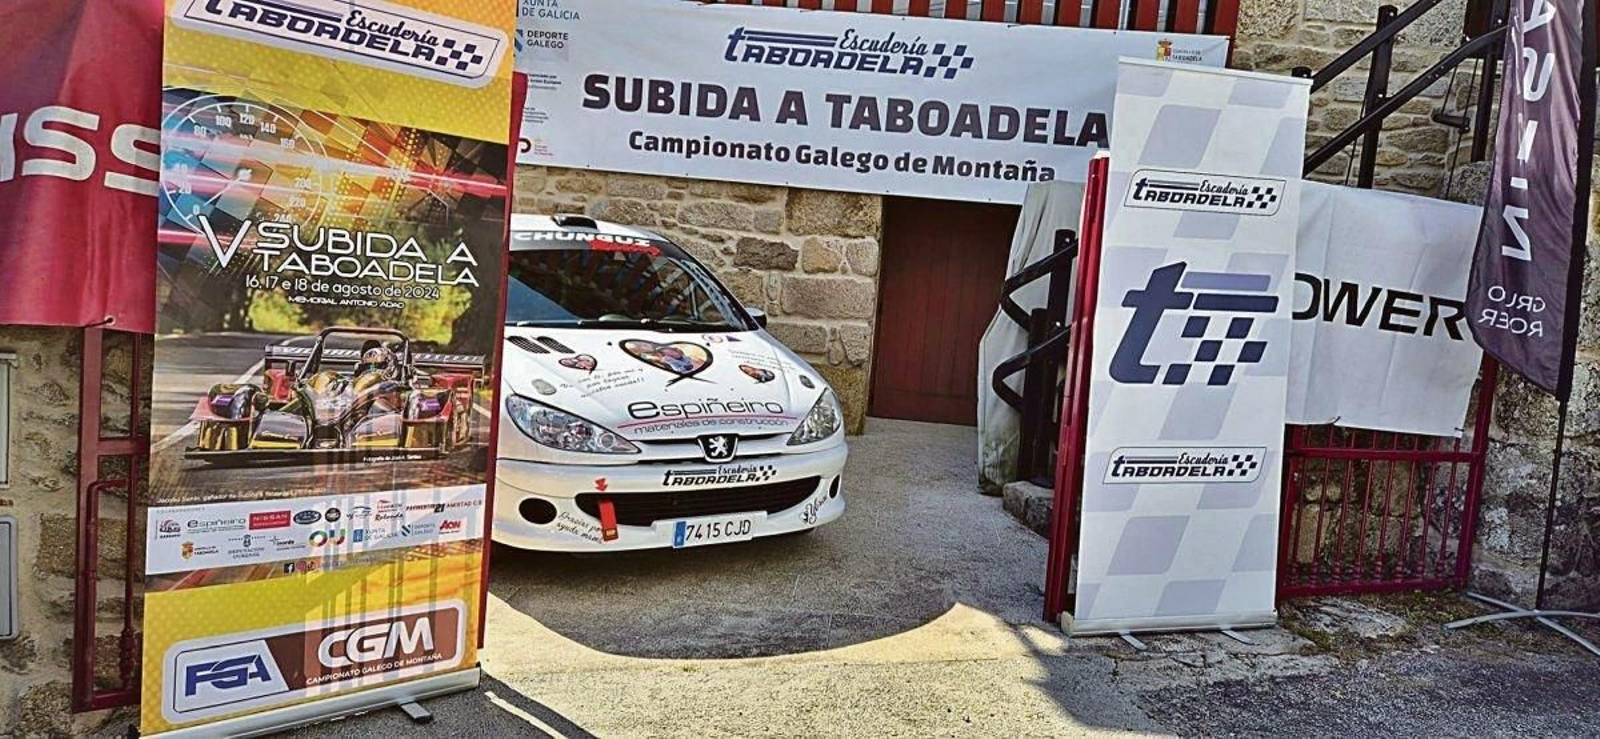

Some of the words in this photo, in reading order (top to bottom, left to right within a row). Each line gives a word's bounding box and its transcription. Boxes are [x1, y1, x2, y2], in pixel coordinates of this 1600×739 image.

[522, 7, 535, 17] DE
[538, 9, 580, 20] GALICIA
[346, 10, 439, 47] Escudería
[528, 30, 569, 40] DEPORTE
[527, 40, 564, 49] GALEGO
[839, 28, 929, 56] Escudería
[240, 113, 255, 125] 120
[582, 73, 761, 122] SUBIDA
[775, 90, 808, 126] A
[825, 93, 1109, 148] TABOADELA
[260, 122, 277, 134] 140
[629, 131, 790, 162] Campionato
[795, 144, 889, 174] Galego
[894, 151, 928, 173] de
[932, 155, 1055, 182] Montaña
[1199, 179, 1249, 196] Escudería
[198, 216, 251, 268] V
[255, 222, 427, 261] SUBIDA
[446, 241, 478, 266] A
[253, 249, 479, 287] TABOADELA
[265, 276, 279, 289] 17
[281, 280, 292, 290] e
[295, 279, 308, 291] 18
[311, 279, 329, 293] de
[332, 281, 381, 297] agosto
[384, 285, 401, 297] de
[404, 286, 440, 299] 2024
[288, 295, 338, 305] MEMORIAL
[340, 298, 378, 307] ANTONIO
[627, 398, 783, 419] espiñeiro
[634, 419, 700, 435] materiales
[703, 418, 717, 426] de
[720, 418, 788, 427] construcción
[1177, 452, 1229, 466] Escudería
[434, 503, 445, 513] 21
[187, 517, 246, 530] espiñeiro
[725, 519, 752, 537] CJD
[318, 617, 434, 668] CGM
[306, 668, 361, 685] CAMPIONATO
[362, 662, 393, 675] GALEGO
[393, 660, 403, 668] DE
[405, 652, 442, 666] MONTAÑA
